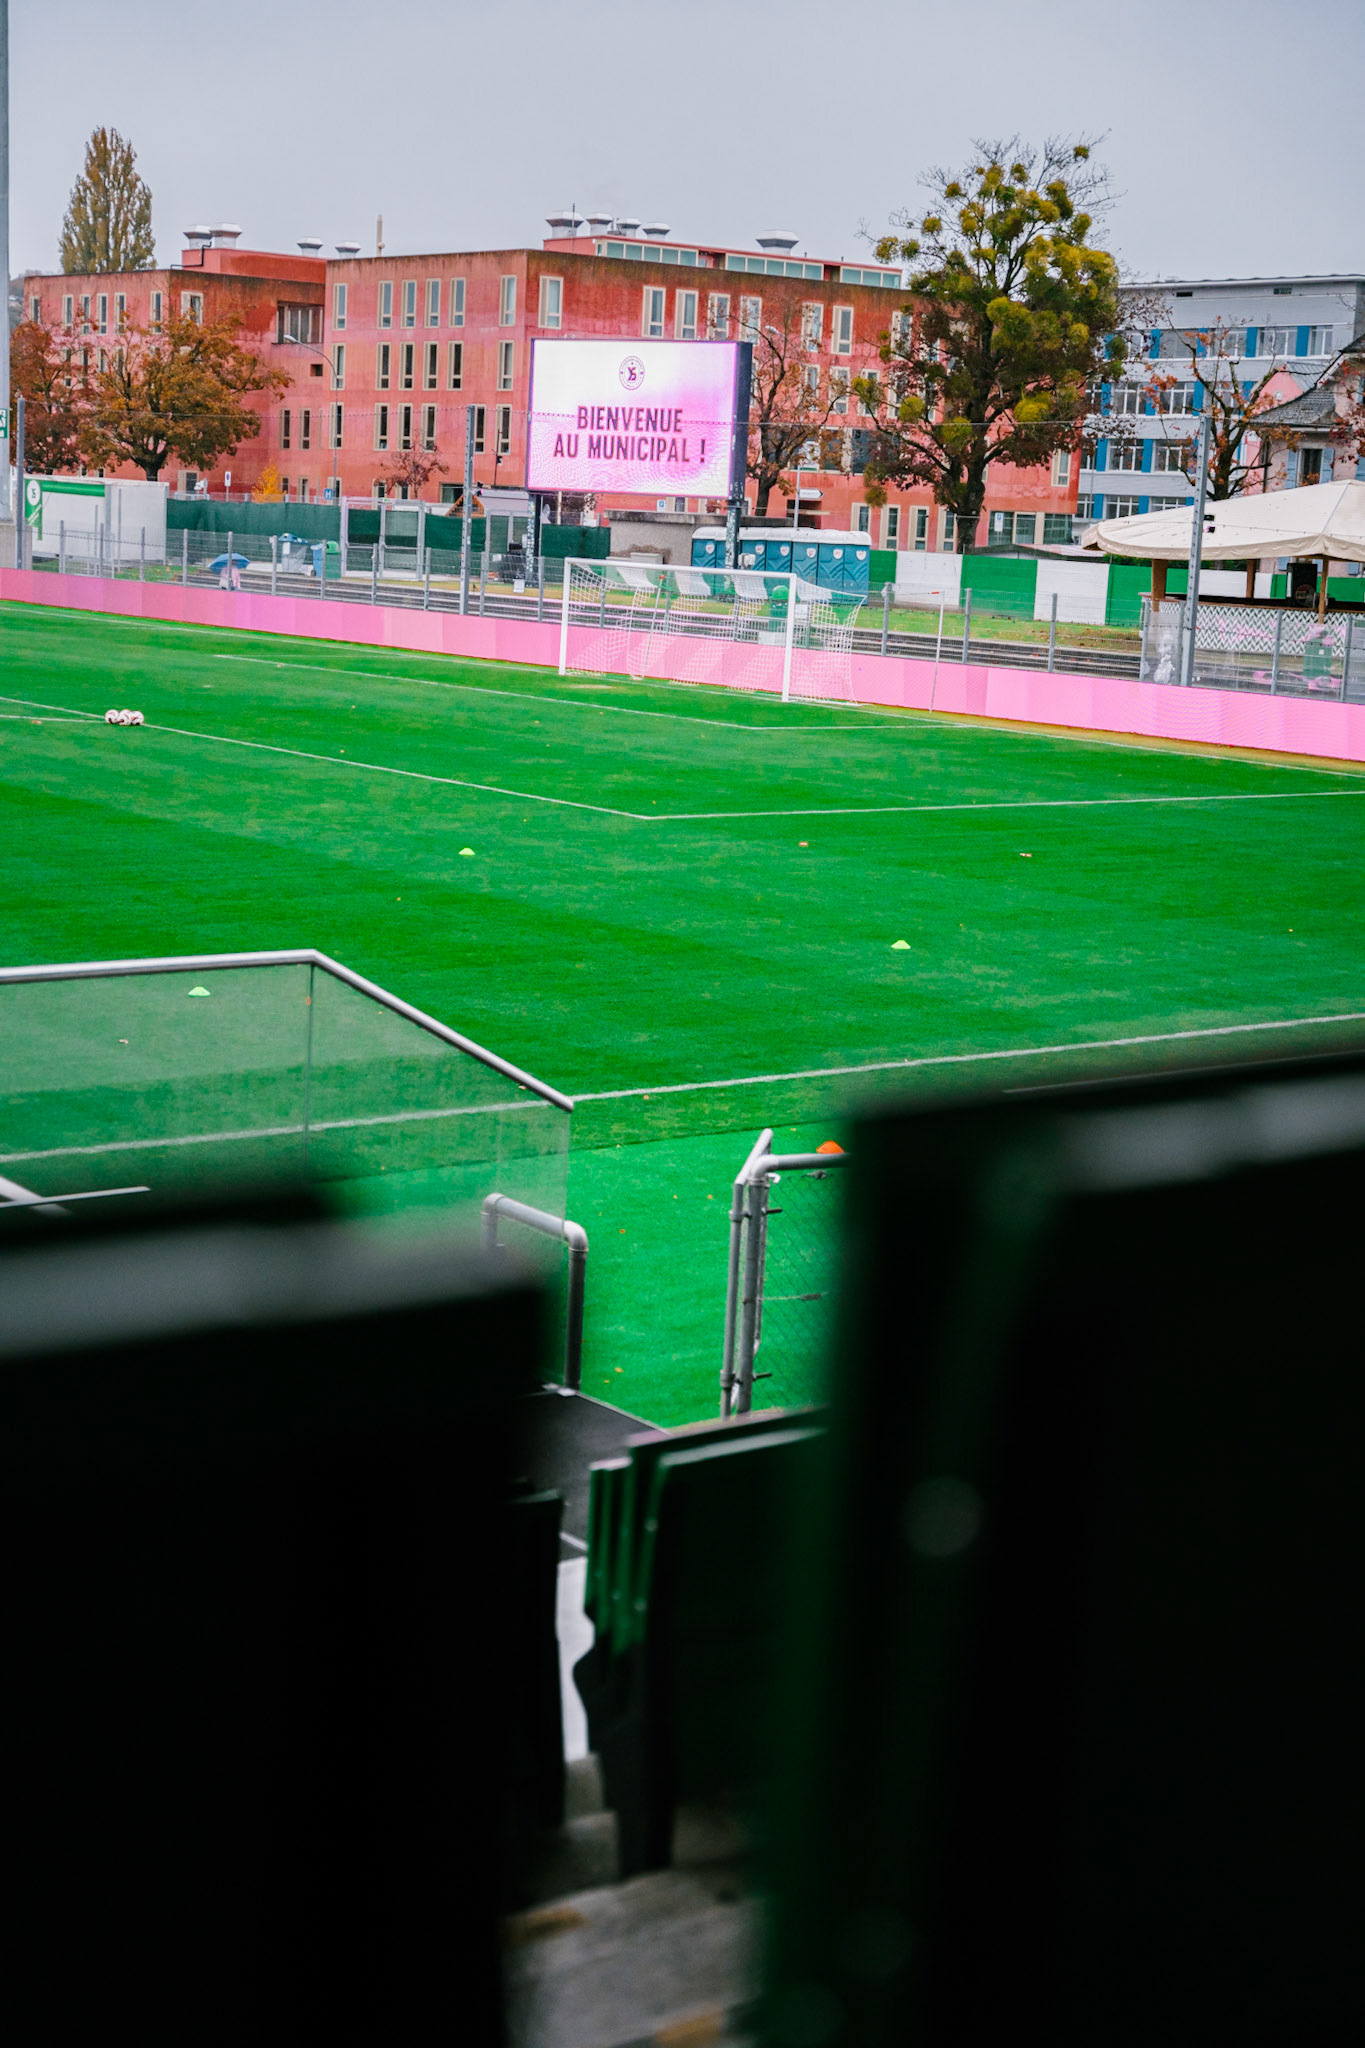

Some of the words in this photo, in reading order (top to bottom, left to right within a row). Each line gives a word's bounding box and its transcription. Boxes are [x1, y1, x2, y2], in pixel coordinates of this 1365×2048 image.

[578, 406, 683, 432] BIENVENUE
[554, 433, 578, 458] AU
[587, 434, 690, 462] MUNICIPAL
